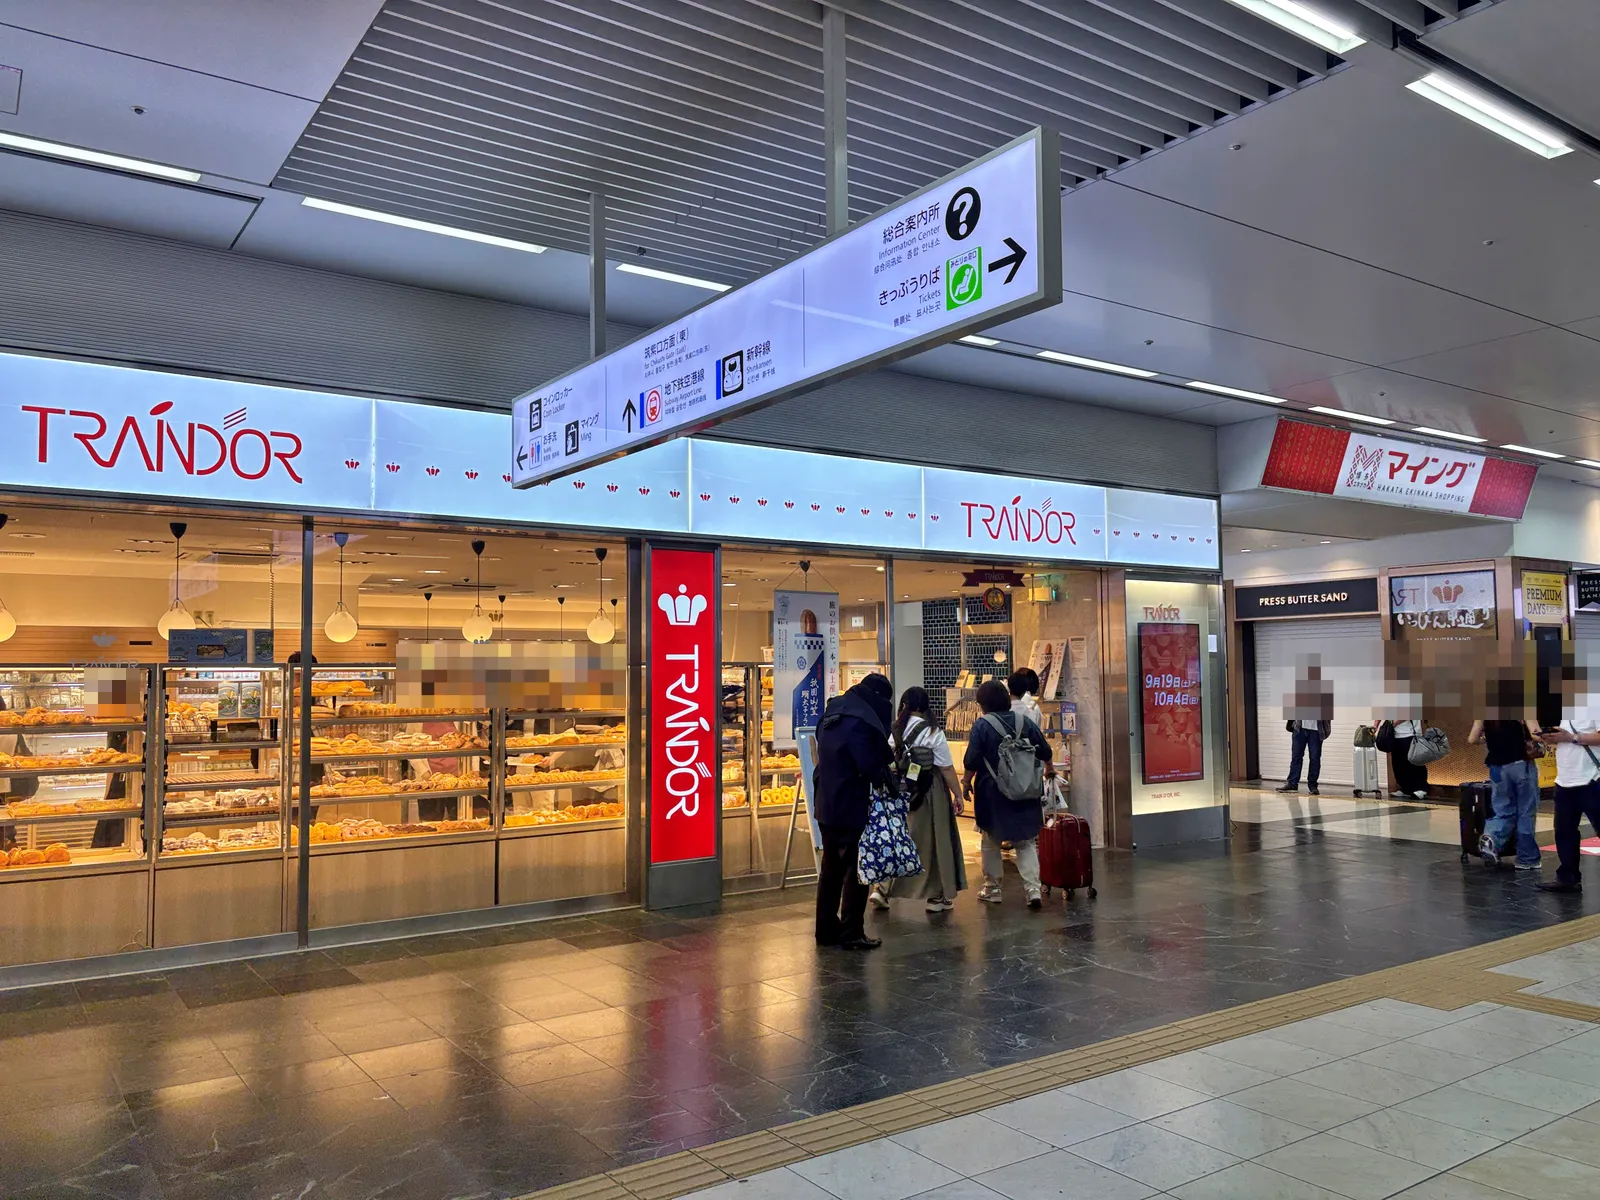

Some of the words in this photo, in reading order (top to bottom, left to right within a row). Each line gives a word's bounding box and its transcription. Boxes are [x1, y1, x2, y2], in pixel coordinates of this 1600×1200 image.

[883, 202, 940, 244] 総合案内所
[879, 237, 916, 259] Information
[918, 225, 940, 241] Center
[879, 265, 940, 306] きっぷうりば
[918, 289, 941, 304] Tickets
[746, 340, 771, 362] 新幹線
[746, 359, 773, 374] Shinkansen
[664, 368, 705, 396] 地下鉄空港線
[543, 387, 573, 407] コインロッカー
[664, 397, 679, 407] Subway
[679, 389, 694, 402] Airport
[543, 409, 552, 418] Coin
[553, 402, 566, 415] Locker
[581, 412, 600, 429] マイング
[1388, 450, 1476, 488] マイング
[1376, 484, 1403, 495] HAKATA
[1405, 487, 1433, 498] EKINAKA
[1434, 491, 1465, 503] SHOPPING
[1259, 596, 1286, 606] PRESS
[1287, 594, 1320, 605] BUTTER
[1320, 592, 1348, 602] SAND
[1526, 587, 1562, 601] PREMIUM
[1527, 602, 1546, 615] DAYS
